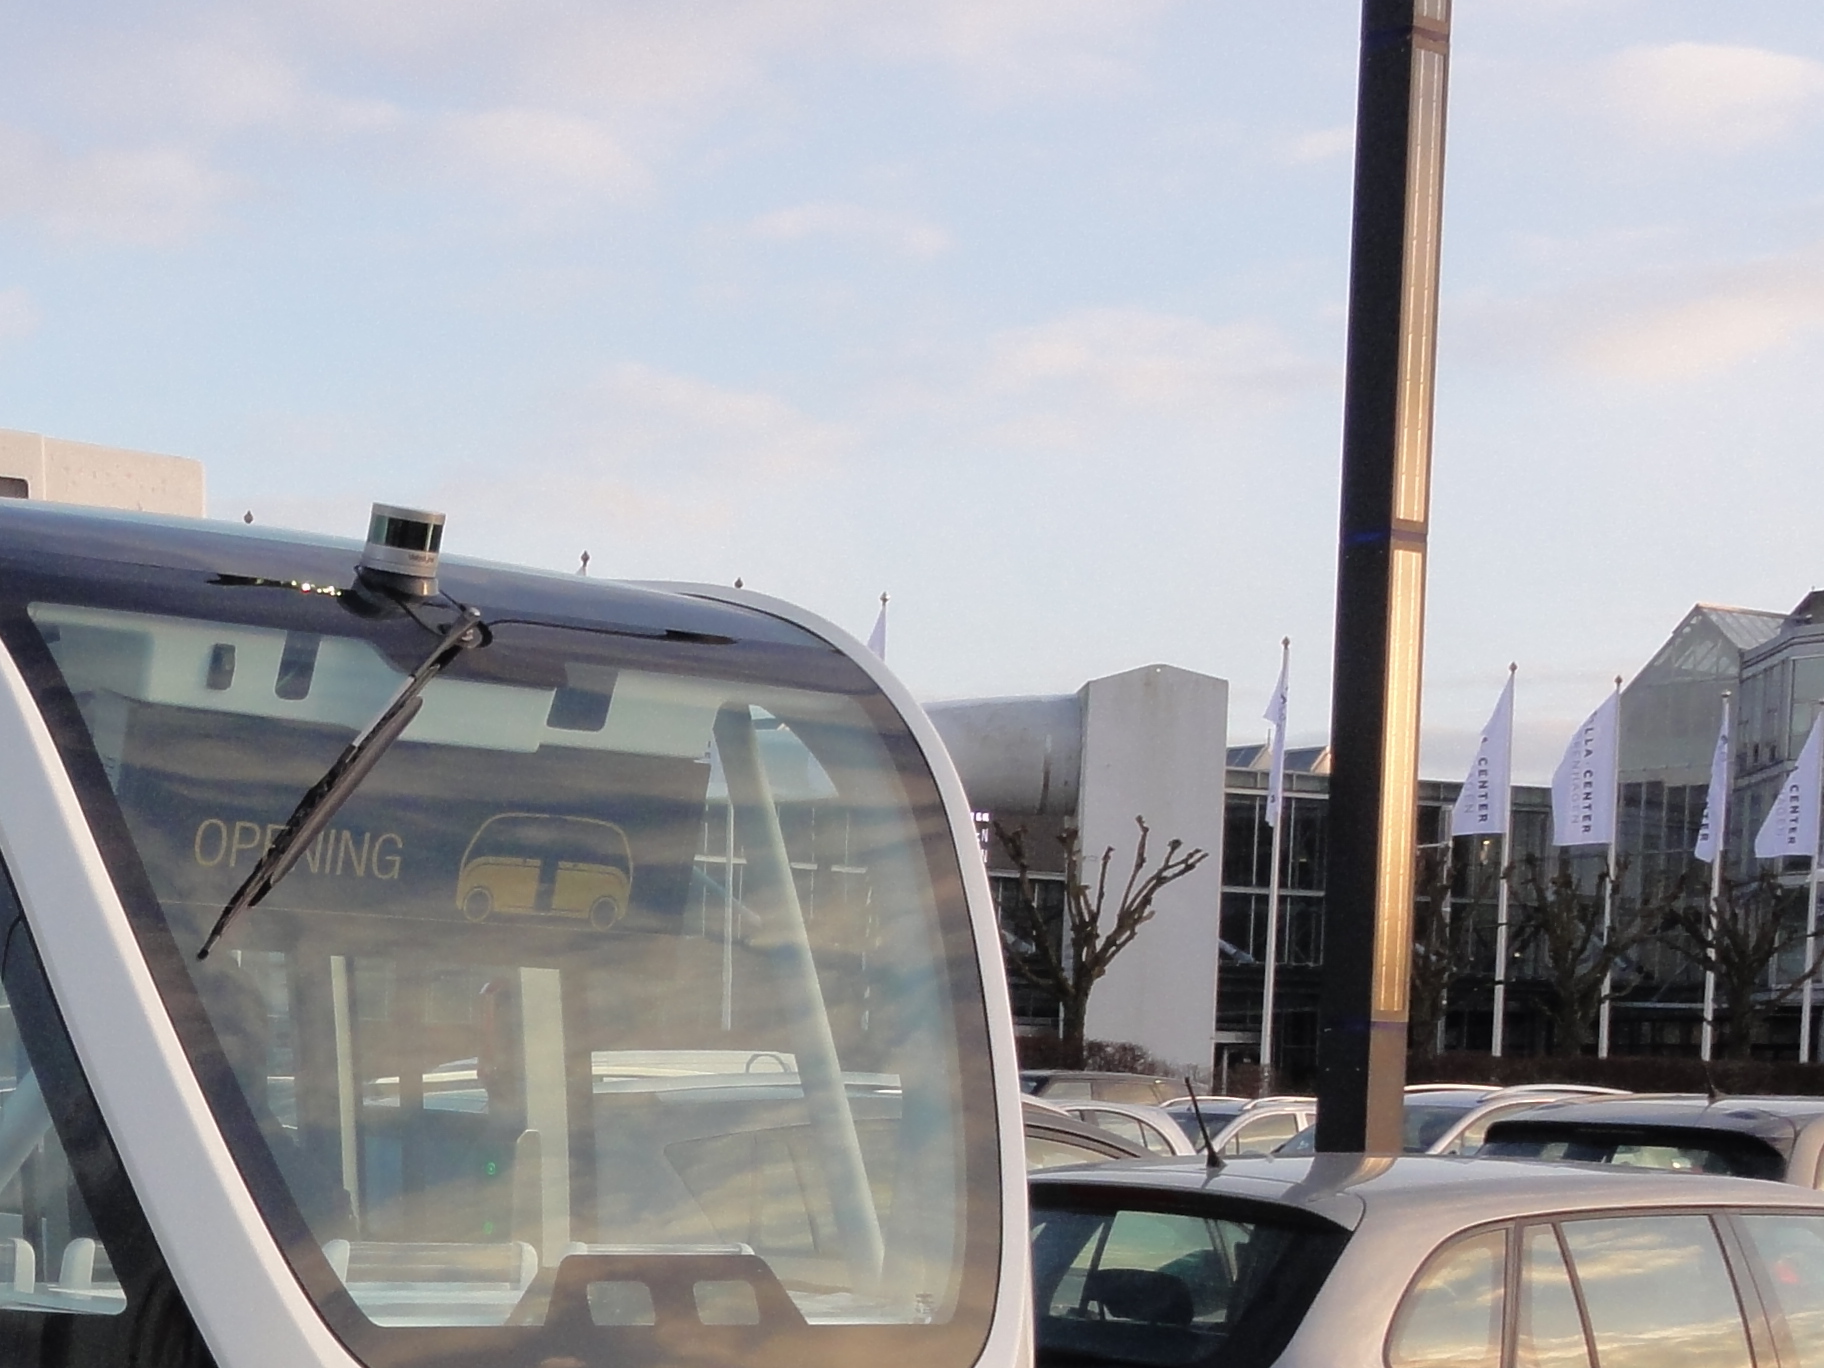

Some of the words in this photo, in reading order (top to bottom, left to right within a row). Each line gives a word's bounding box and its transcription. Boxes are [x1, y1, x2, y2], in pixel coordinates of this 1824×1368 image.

[1477, 757, 1489, 823] CENTER
[1581, 769, 1594, 833] CENTER
[1787, 784, 1800, 844] CENTER
